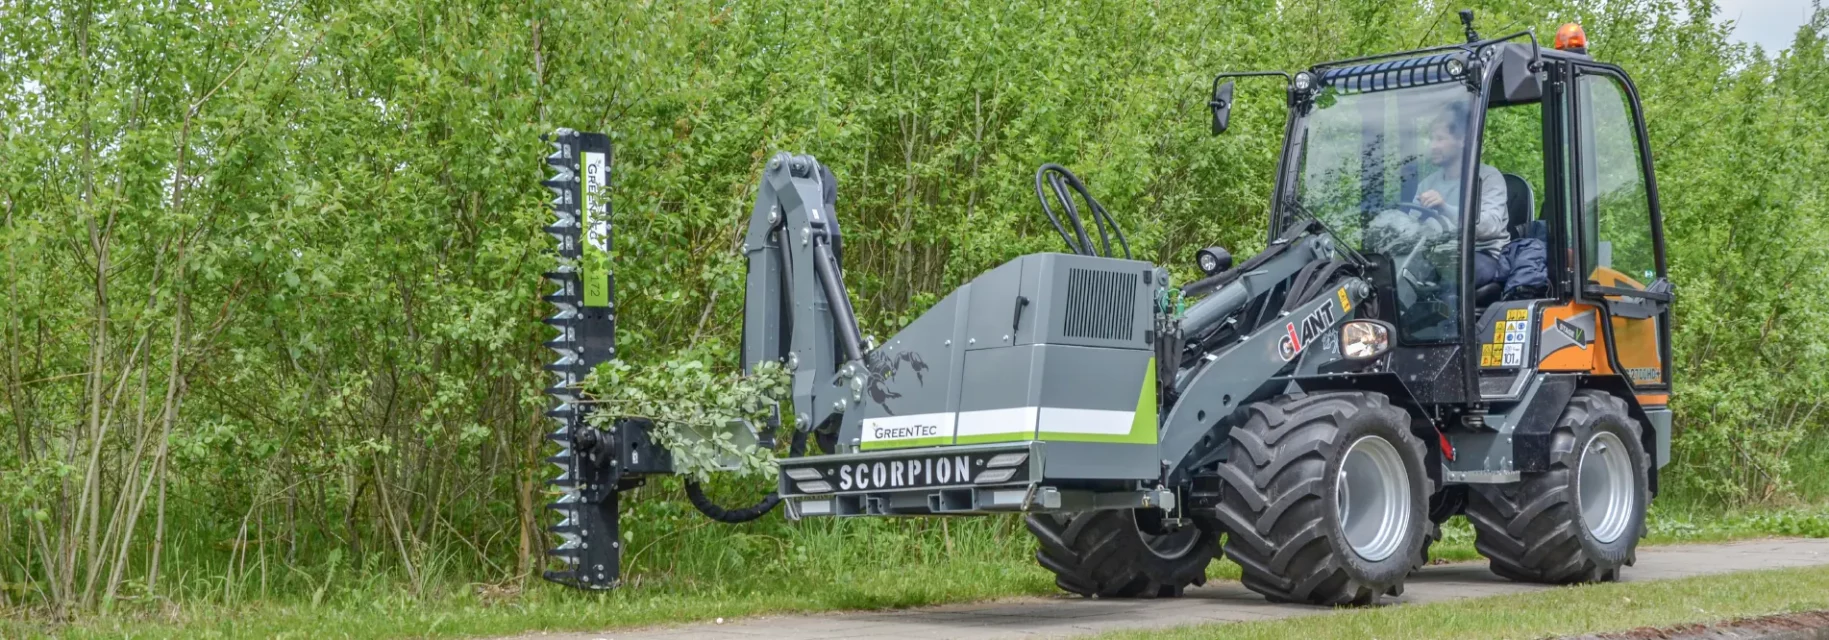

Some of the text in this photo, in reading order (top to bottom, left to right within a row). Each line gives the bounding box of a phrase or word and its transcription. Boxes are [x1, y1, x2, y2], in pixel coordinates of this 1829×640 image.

[590, 275, 600, 297] 172
[1504, 352, 1515, 364] 101
[839, 456, 970, 490] SCORPION
